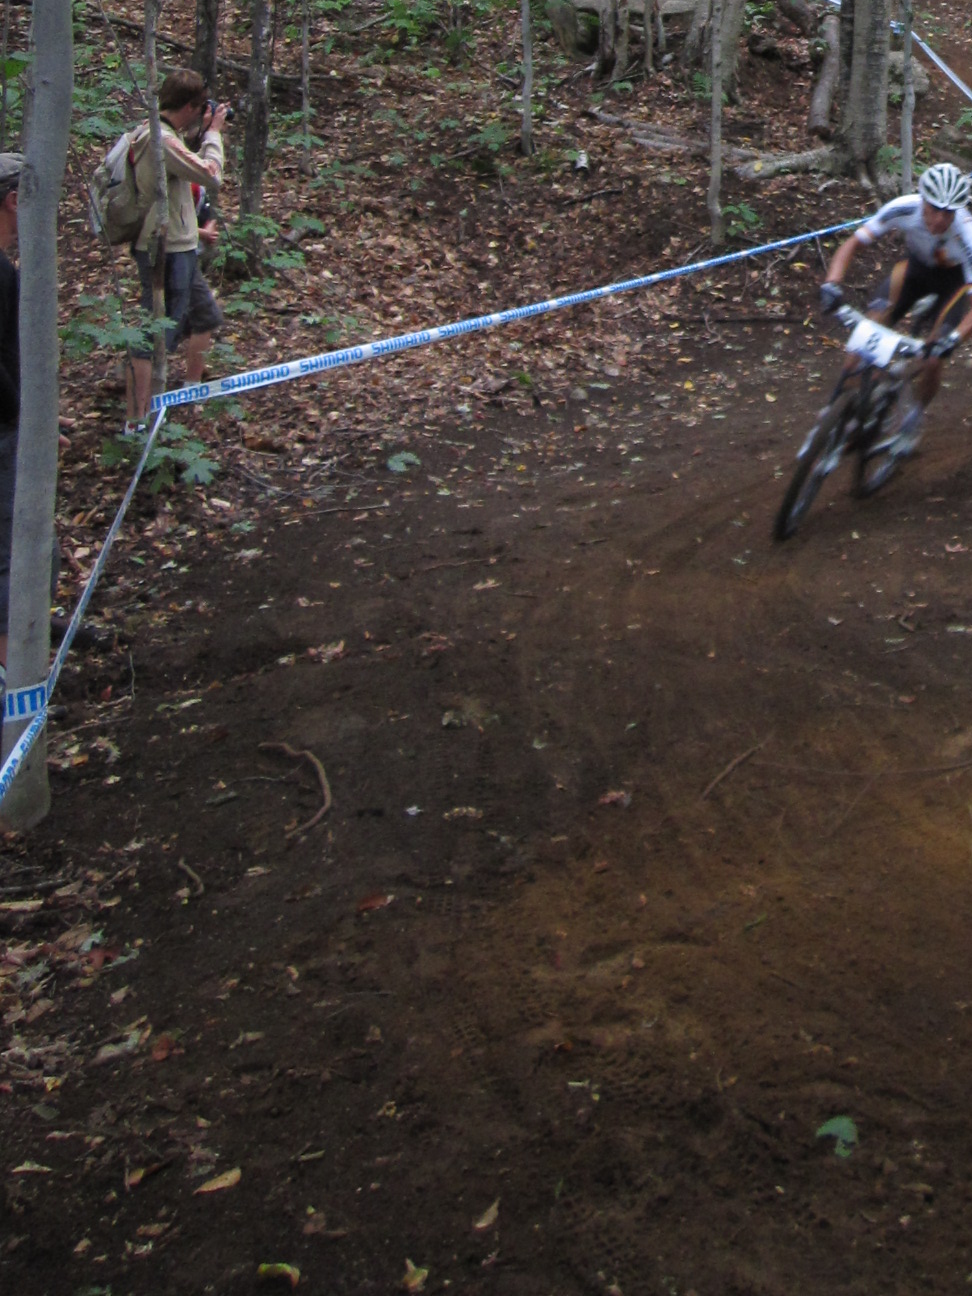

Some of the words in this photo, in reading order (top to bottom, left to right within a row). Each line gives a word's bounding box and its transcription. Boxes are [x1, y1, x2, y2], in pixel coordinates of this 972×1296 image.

[220, 365, 290, 392] SHIMANO
[299, 347, 363, 373] SHIMANO
[371, 331, 431, 355] SHIMANO
[438, 315, 493, 338] SHIMANO
[500, 303, 550, 322] SHIMANO
